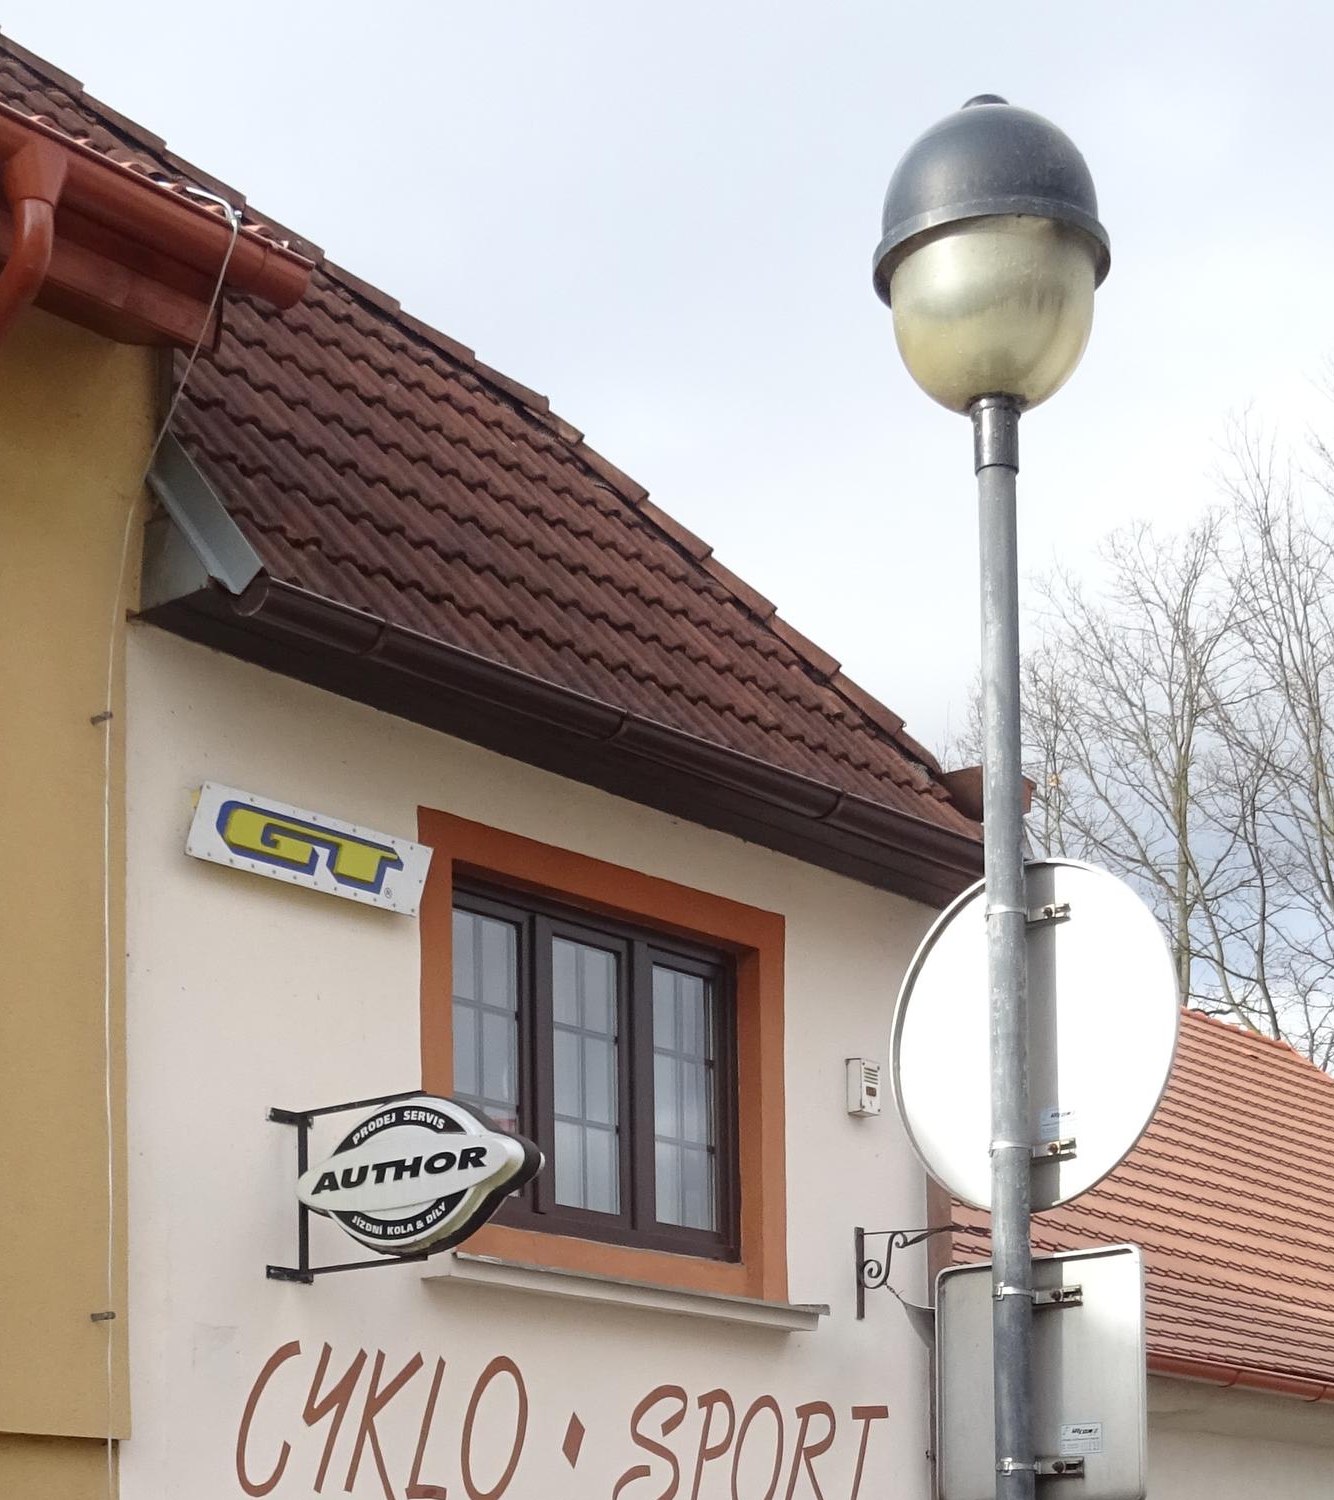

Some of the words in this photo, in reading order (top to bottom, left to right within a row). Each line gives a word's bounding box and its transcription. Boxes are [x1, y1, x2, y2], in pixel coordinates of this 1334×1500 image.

[215, 799, 404, 895] GT
[352, 1112, 396, 1145] PRODEJ
[403, 1110, 445, 1130] SERVIS
[311, 1146, 487, 1195] AUTHOR
[351, 1214, 383, 1236] JÍZDNÍ
[387, 1222, 414, 1236] KOLA
[426, 1200, 447, 1224] DÍLY
